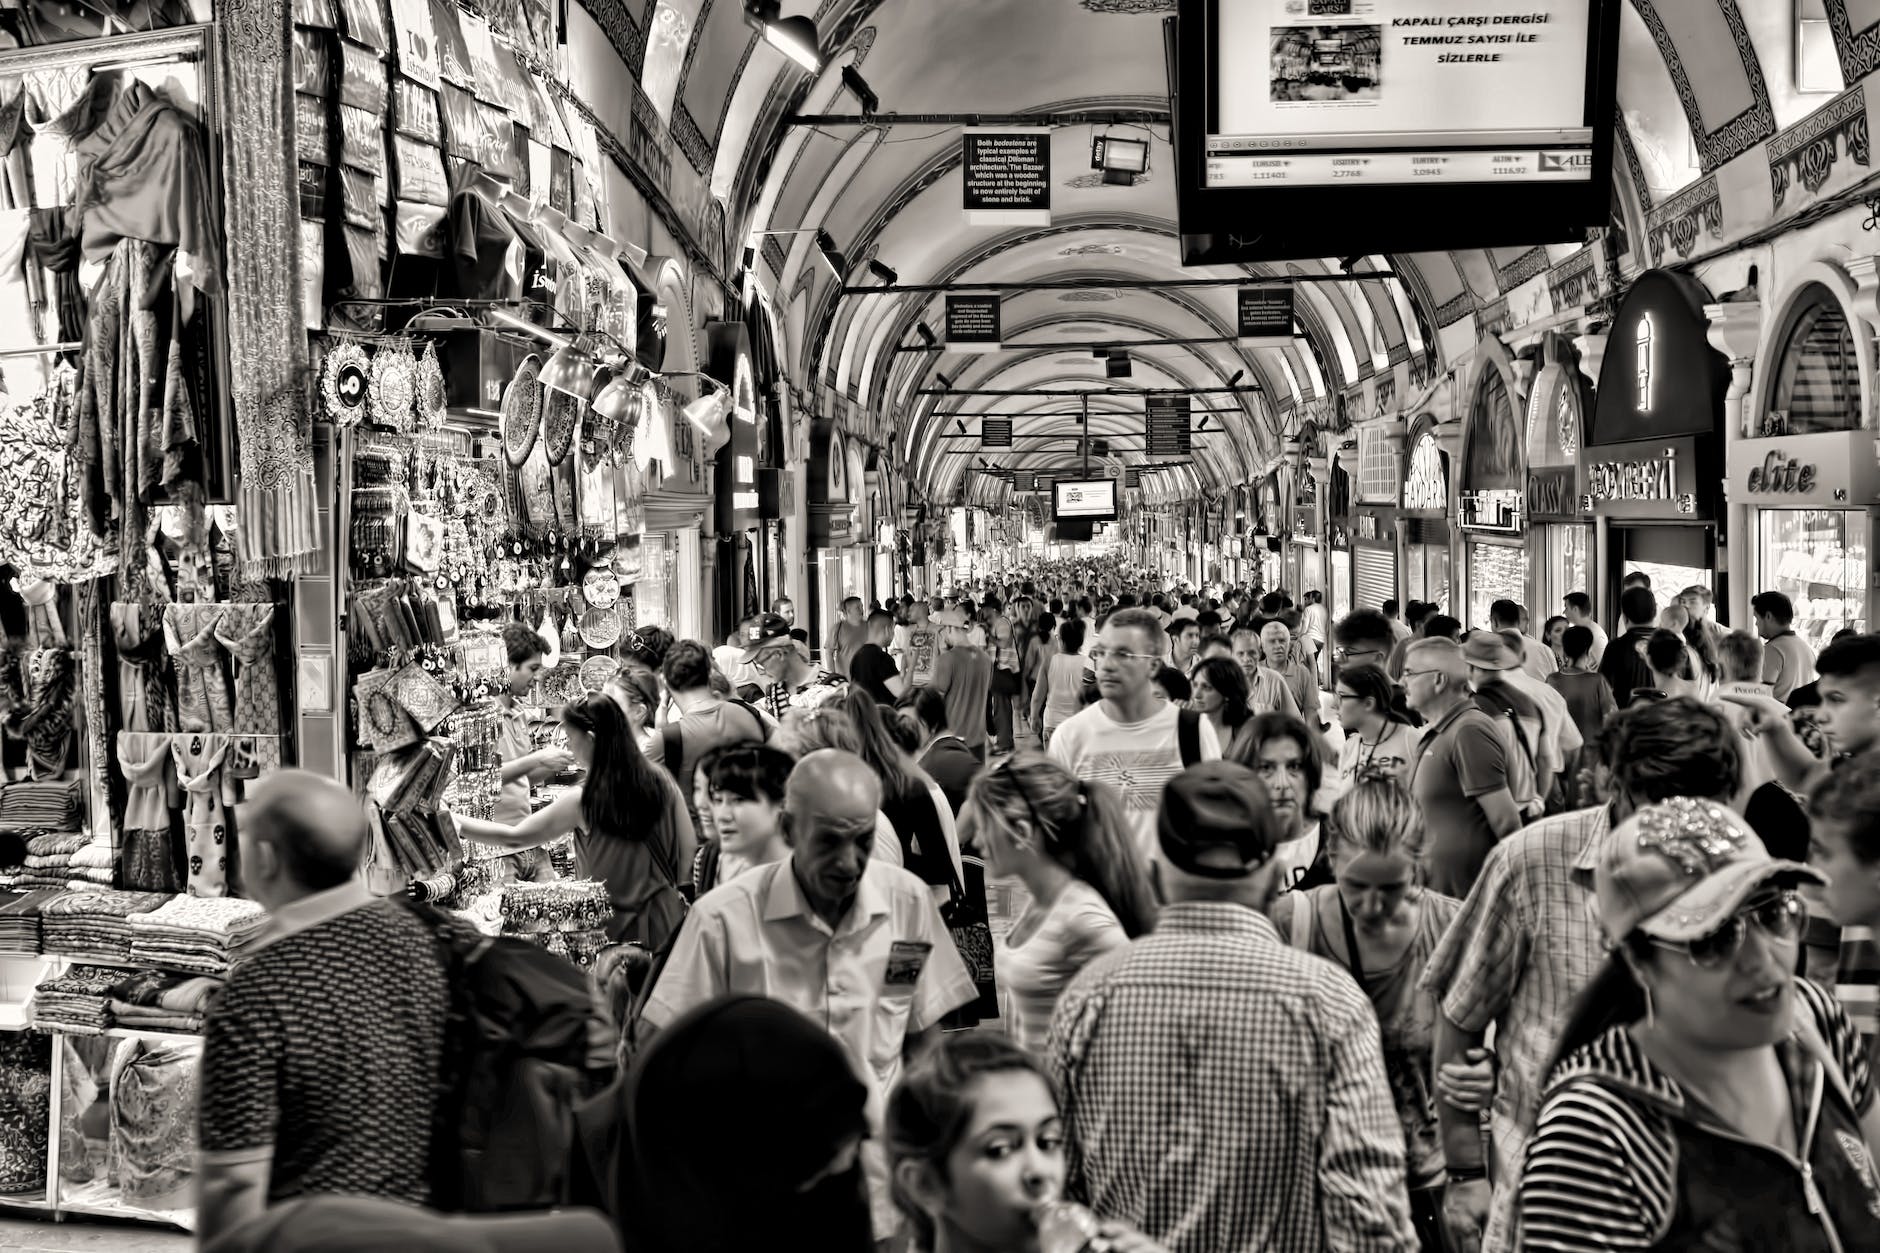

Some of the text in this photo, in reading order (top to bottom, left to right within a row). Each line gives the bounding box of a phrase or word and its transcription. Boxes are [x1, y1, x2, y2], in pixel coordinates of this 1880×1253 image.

[1392, 12, 1549, 27] KAPALI ÇARŞI DERGİSİ
[1403, 32, 1537, 45] TEMMUZ SAYISI İLE
[1438, 53, 1501, 63] SİZLERLE
[977, 139, 993, 147] Both
[993, 139, 1026, 147] bedestens
[977, 147, 1037, 156] typical examples of
[979, 155, 1035, 163] classical Ottoman
[1009, 163, 1022, 171] The
[1022, 163, 1044, 171] Bazaar
[975, 171, 994, 179] which
[1013, 171, 1039, 179] wooden
[1015, 180, 1047, 188] beginning
[994, 188, 1018, 196] entirely
[1747, 449, 1817, 494] elite
